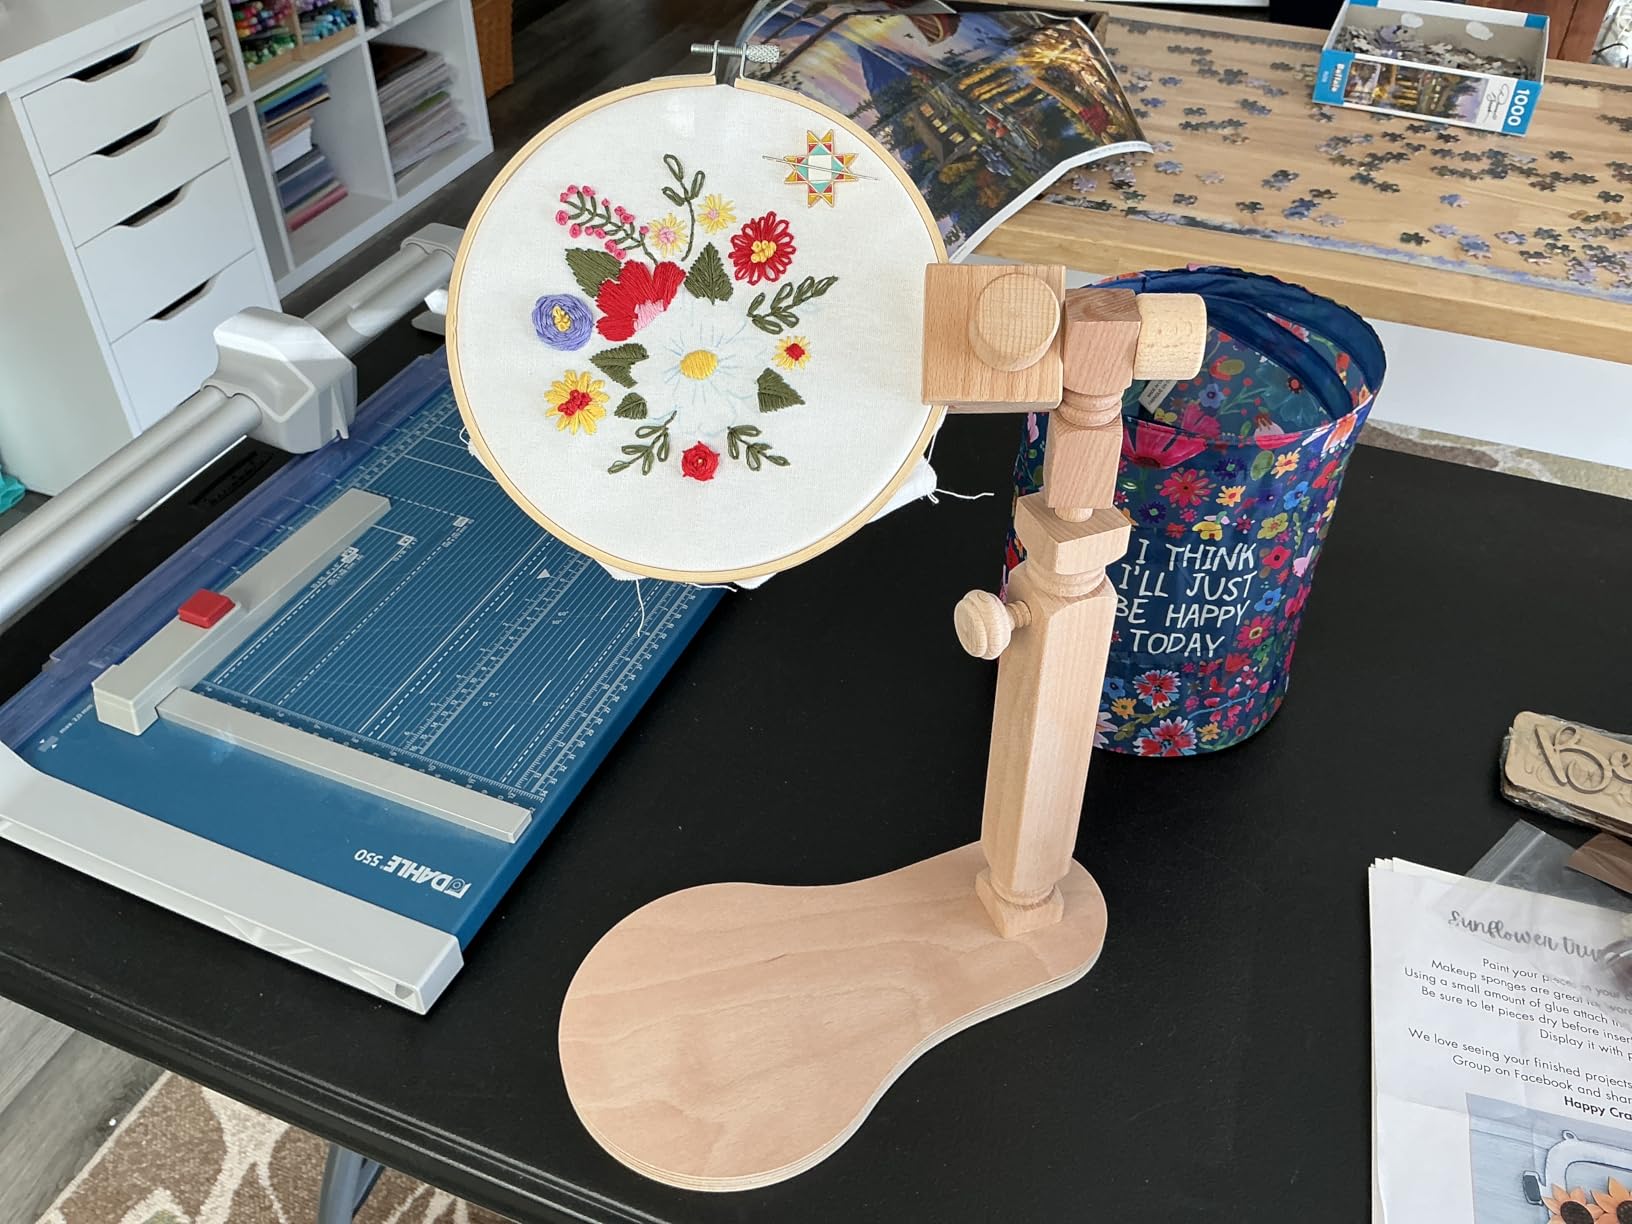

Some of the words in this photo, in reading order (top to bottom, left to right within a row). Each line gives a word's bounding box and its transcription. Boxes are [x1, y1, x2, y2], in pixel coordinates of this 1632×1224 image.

[1507, 88, 1531, 127] 1000
[1135, 538, 1150, 565] I
[1165, 543, 1257, 572] THINK
[1118, 563, 1169, 598] I'LL
[1185, 570, 1258, 602] JUST
[1115, 594, 1149, 624] BE
[1165, 599, 1251, 629] HAPPY
[1130, 629, 1226, 658] TODAY
[354, 849, 384, 867] 550
[383, 854, 454, 892] DAHLE
[1448, 910, 1559, 952] Sunflower
[1431, 959, 1477, 980] Makeup
[1481, 975, 1527, 991] sponges
[1530, 986, 1550, 995] are
[1482, 958, 1510, 973] Paint
[1512, 969, 1538, 979] your
[1404, 966, 1437, 985] Using
[1440, 978, 1448, 986] a
[1451, 981, 1480, 995] small
[1484, 989, 1526, 1006] amount
[1529, 998, 1541, 1008] of
[1544, 1001, 1570, 1013] glue
[1573, 1009, 1608, 1024] attach
[1421, 985, 1436, 997] Be
[1440, 993, 1463, 1005] sure
[1466, 998, 1478, 1008] to
[1481, 1000, 1495, 1012] let
[1498, 1007, 1535, 1022] pieces
[1538, 1014, 1558, 1028] dry
[1561, 1018, 1600, 1036] before
[1408, 1027, 1431, 1041] We
[1434, 1033, 1458, 1049] love
[1462, 1043, 1500, 1062] seeing
[1503, 1054, 1530, 1065] your
[1534, 1056, 1581, 1077] finished
[1540, 1028, 1584, 1050] Display
[1587, 1039, 1596, 1050] it
[1598, 1043, 1624, 1057] with
[1452, 1054, 1491, 1074] Group
[1495, 1067, 1510, 1077] on
[1514, 1068, 1574, 1092] Facebook
[1577, 1085, 1601, 1098] and
[1563, 1095, 1606, 1117] Happy
